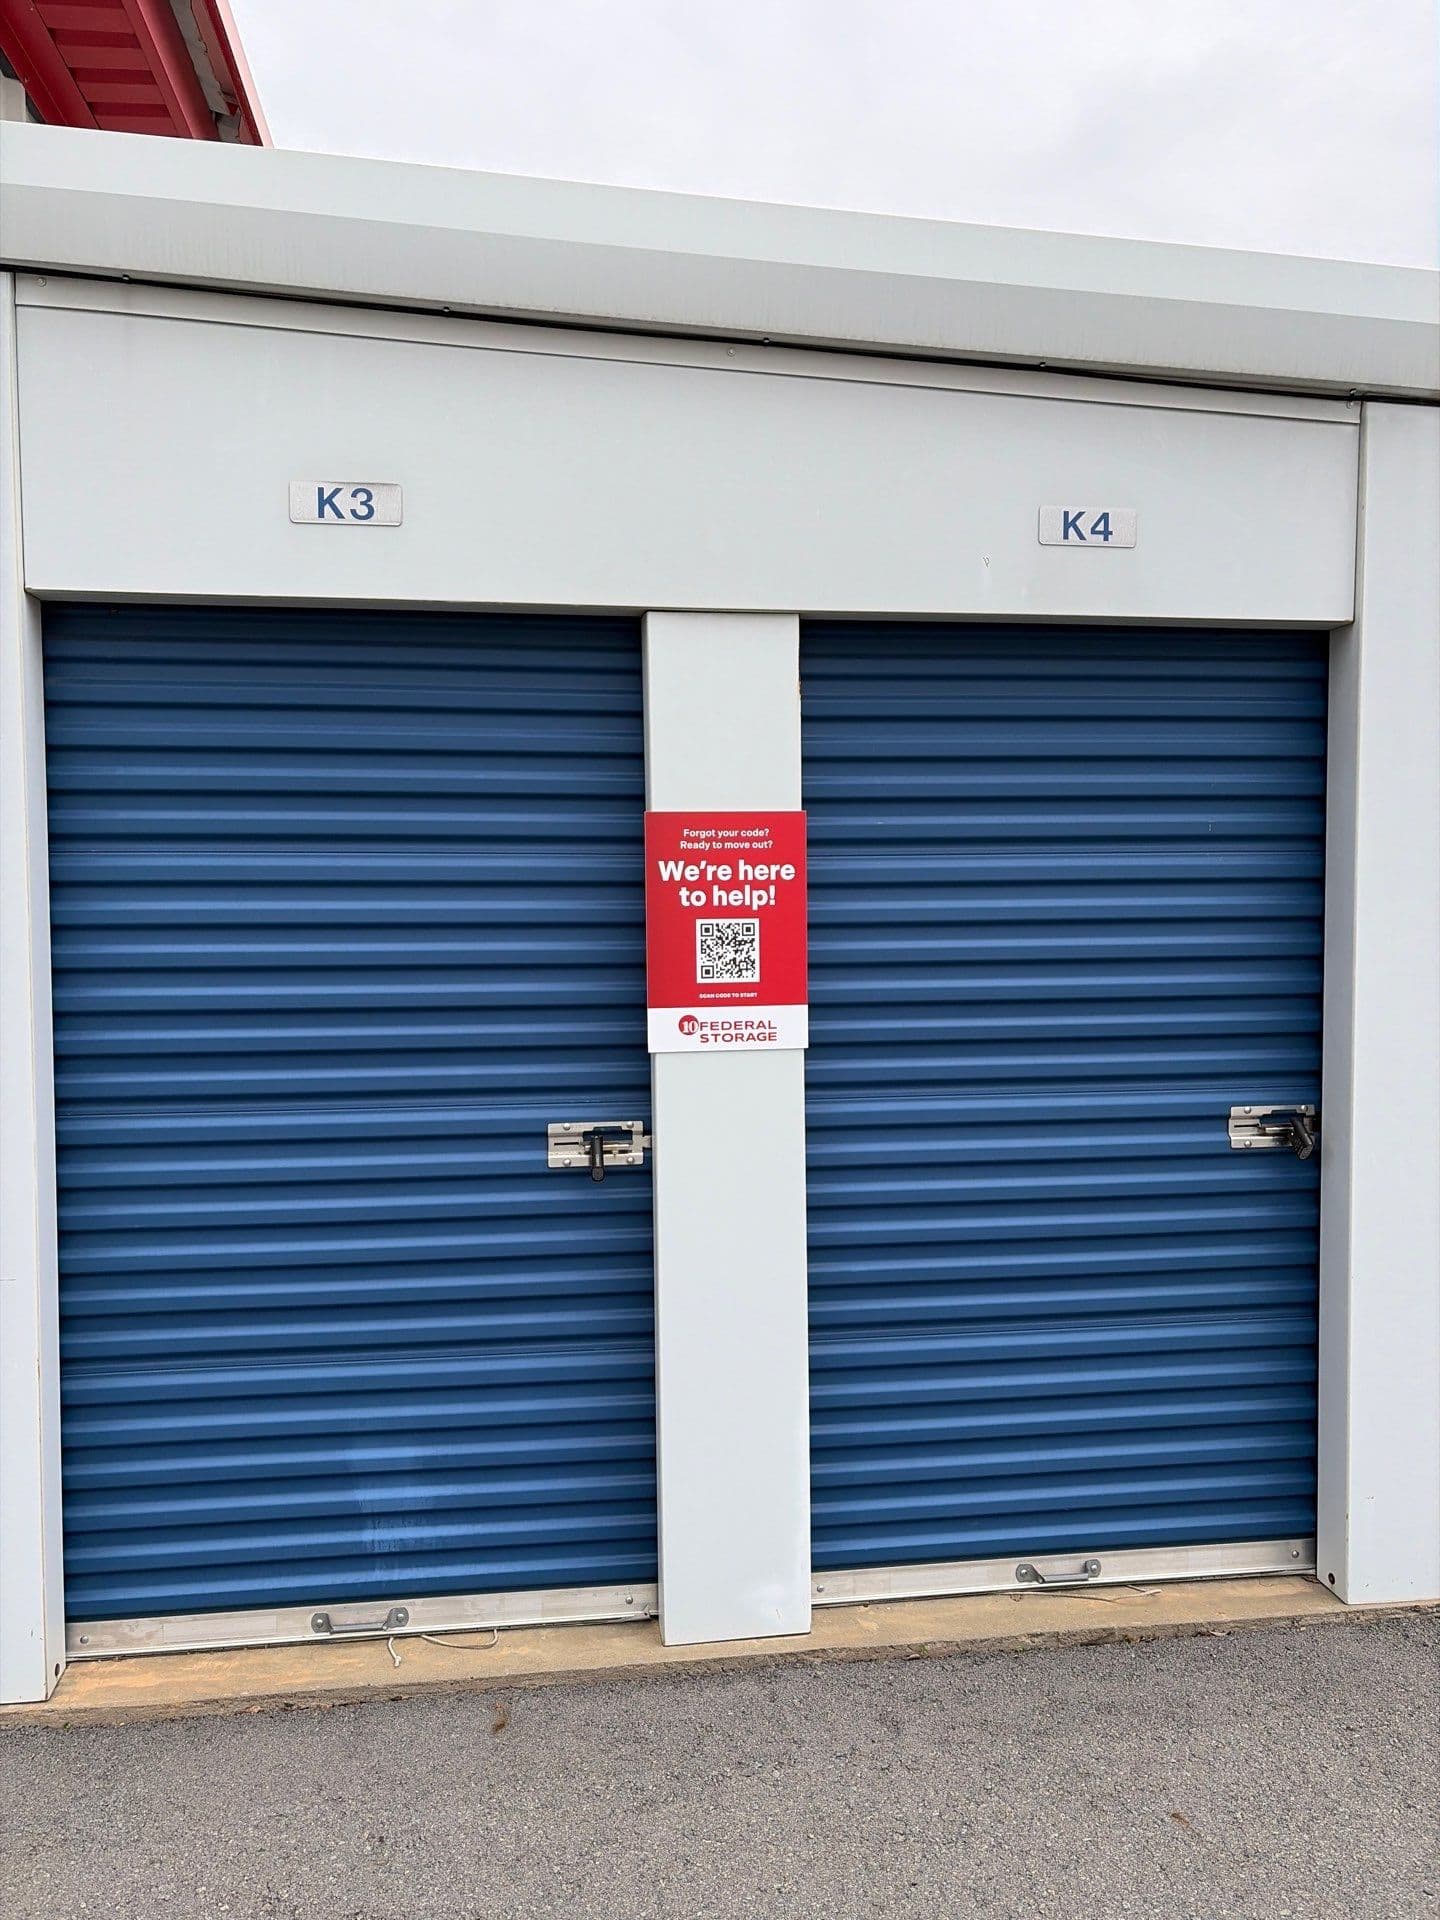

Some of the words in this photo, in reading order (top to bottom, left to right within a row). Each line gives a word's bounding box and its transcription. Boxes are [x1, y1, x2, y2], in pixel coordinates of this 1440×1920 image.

[315, 485, 375, 521] K3
[1062, 510, 1114, 542] K4
[683, 828, 715, 839] Forgot
[717, 830, 739, 839] your
[740, 828, 770, 837] code?
[680, 840, 710, 851] Ready
[712, 841, 723, 849] to
[751, 840, 773, 849] out?
[658, 860, 733, 882] We're
[738, 859, 796, 881] here
[679, 887, 707, 907] to
[712, 885, 776, 911] help!
[700, 1020, 778, 1031] FEDERAL
[700, 1032, 778, 1043] STORAGE
